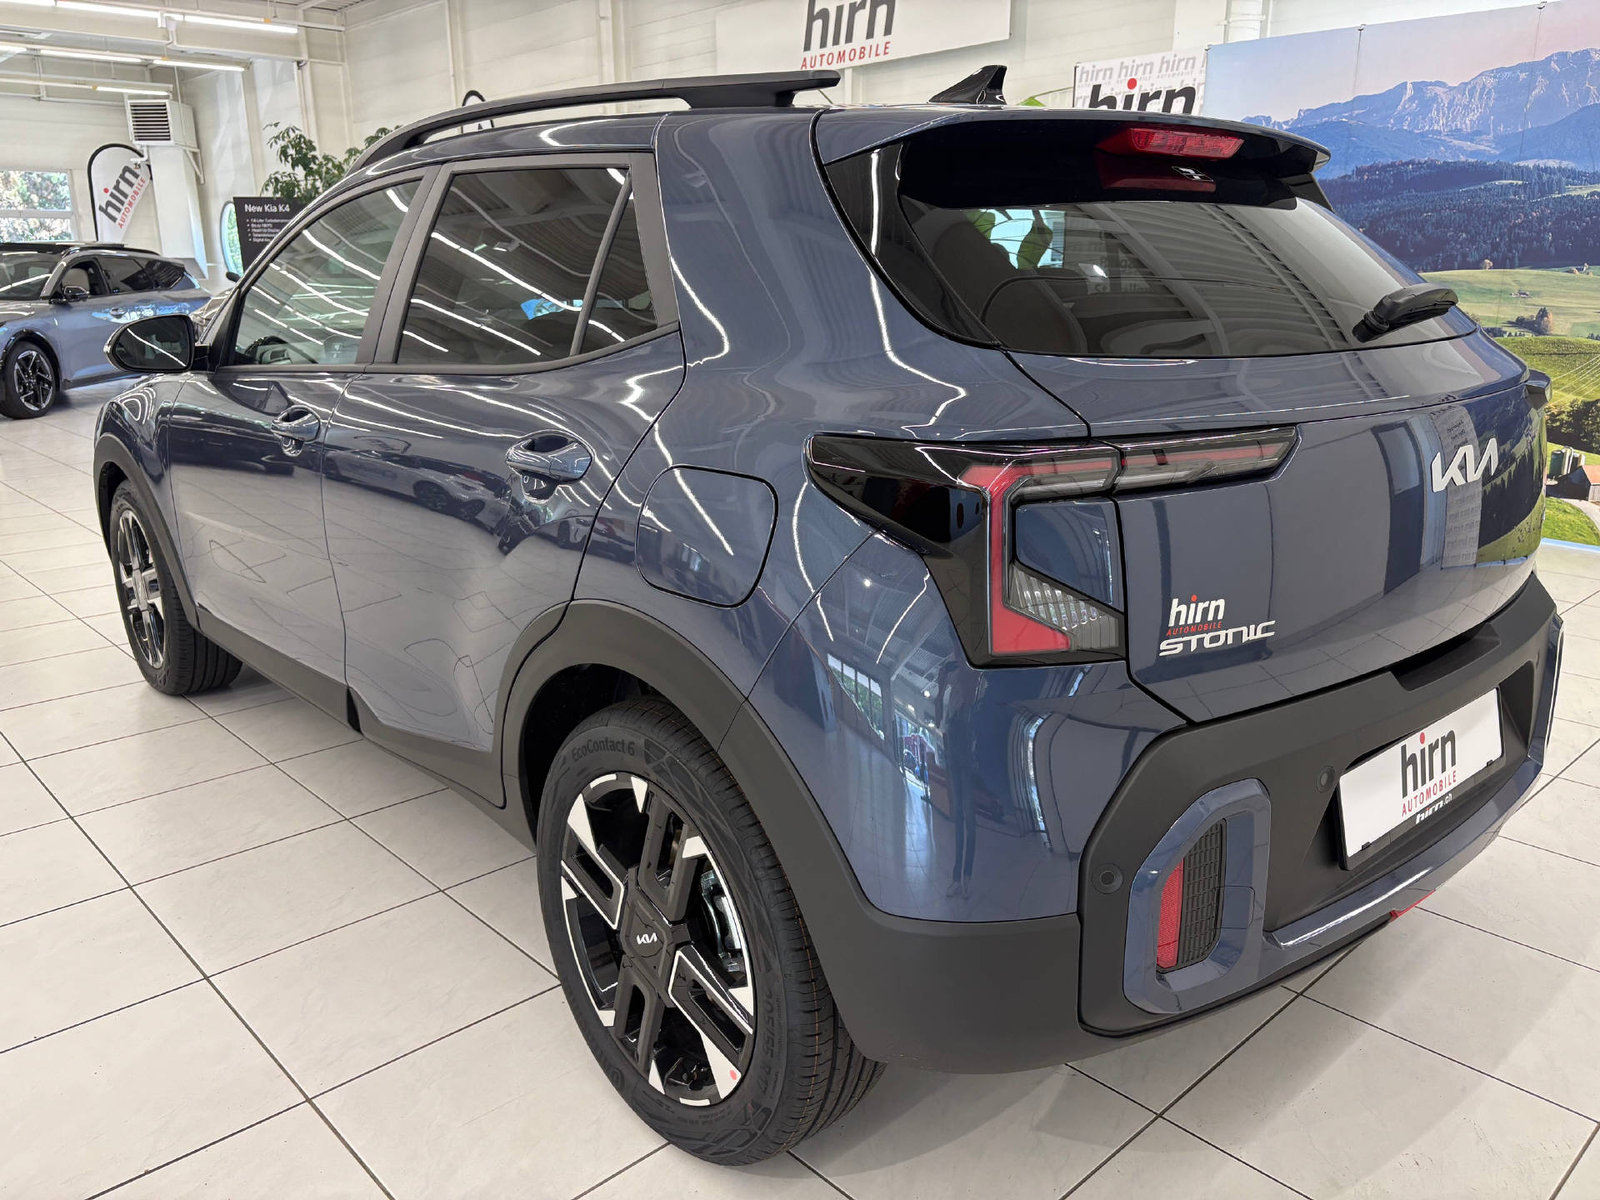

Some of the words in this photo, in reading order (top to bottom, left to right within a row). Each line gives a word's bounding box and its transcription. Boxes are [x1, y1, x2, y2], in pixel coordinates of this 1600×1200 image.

[803, 0, 896, 52] hirn
[800, 41, 891, 70] AUTOMOBILE
[1079, 65, 1114, 83] hirn
[1118, 60, 1154, 77] hirn
[1159, 54, 1196, 73] hirn
[98, 165, 140, 223] hirn
[117, 177, 146, 229] AUTOMOBILE
[244, 203, 263, 213] New
[264, 203, 278, 213] Kia
[278, 203, 290, 213] K4
[1431, 437, 1499, 493] KIA
[1168, 594, 1225, 628] hirn
[1159, 620, 1276, 657] STONIC
[1166, 621, 1223, 637] AUTOMOBILE
[571, 736, 626, 762] EcoContact
[627, 741, 635, 756] 6
[1401, 730, 1456, 799] hirn
[1401, 770, 1456, 817] AUTOMOBILE
[636, 932, 658, 945] KIA
